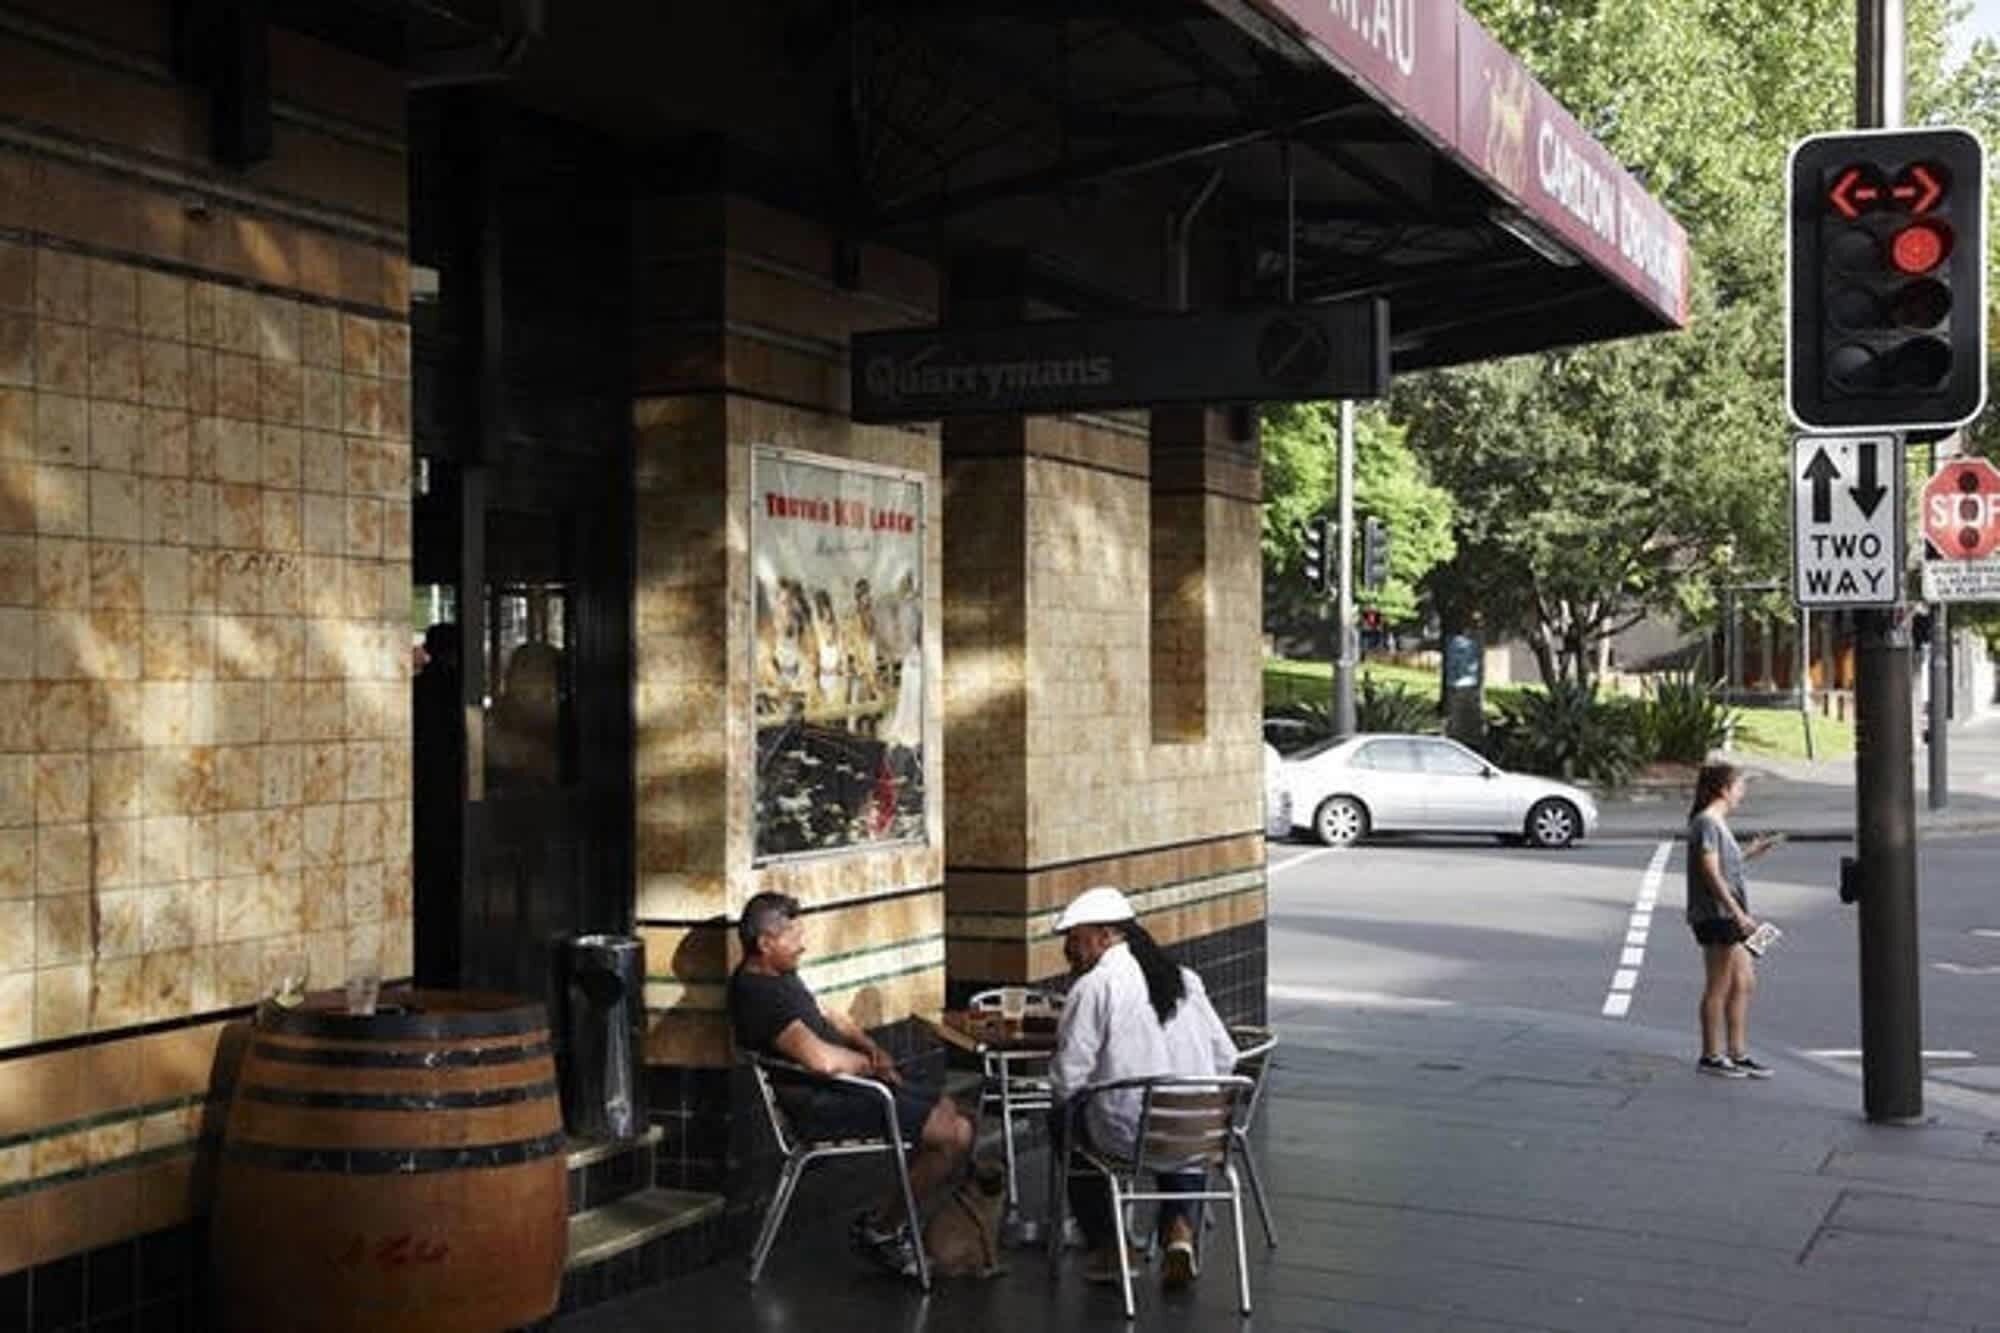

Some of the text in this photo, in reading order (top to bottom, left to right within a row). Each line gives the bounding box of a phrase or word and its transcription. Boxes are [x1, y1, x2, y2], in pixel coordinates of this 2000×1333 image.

[1328, 0, 1415, 75] .AU
[865, 351, 1114, 399] Quarrymans
[1810, 533, 1882, 559] TWO
[1806, 568, 1885, 595] WAY
